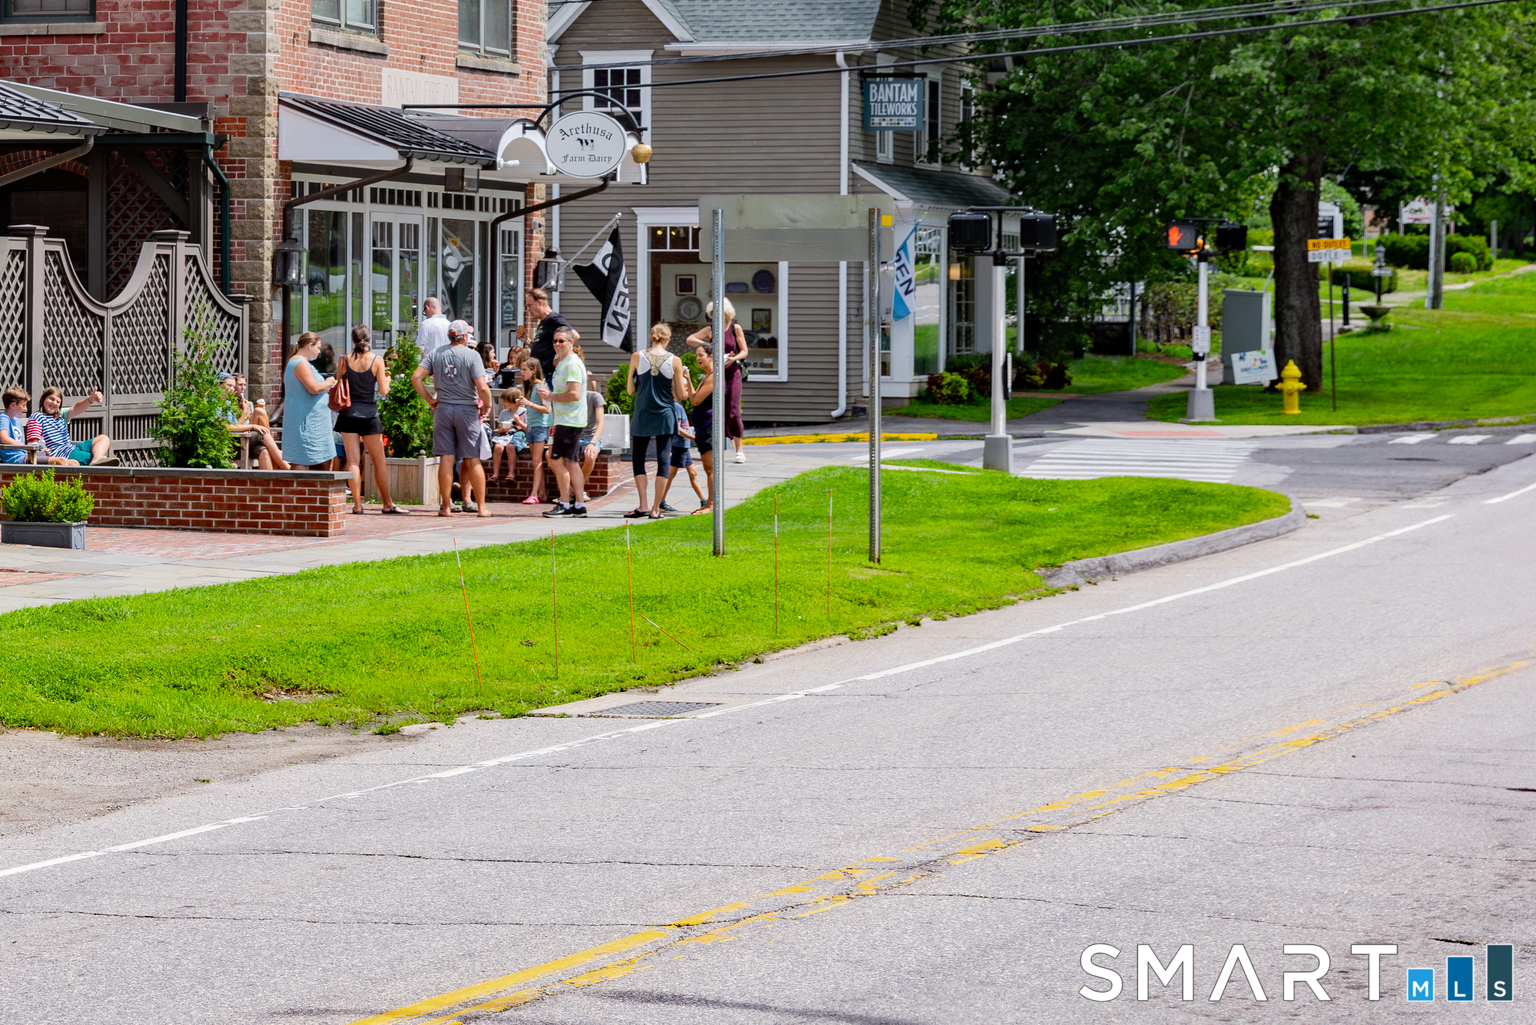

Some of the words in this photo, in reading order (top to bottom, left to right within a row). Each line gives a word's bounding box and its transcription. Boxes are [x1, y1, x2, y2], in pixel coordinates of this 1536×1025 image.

[869, 83, 918, 102] BANTAM
[869, 102, 918, 116] TILEWORKS
[559, 123, 613, 141] Arethusa
[561, 154, 585, 164] Farm
[588, 154, 613, 164] Dairy
